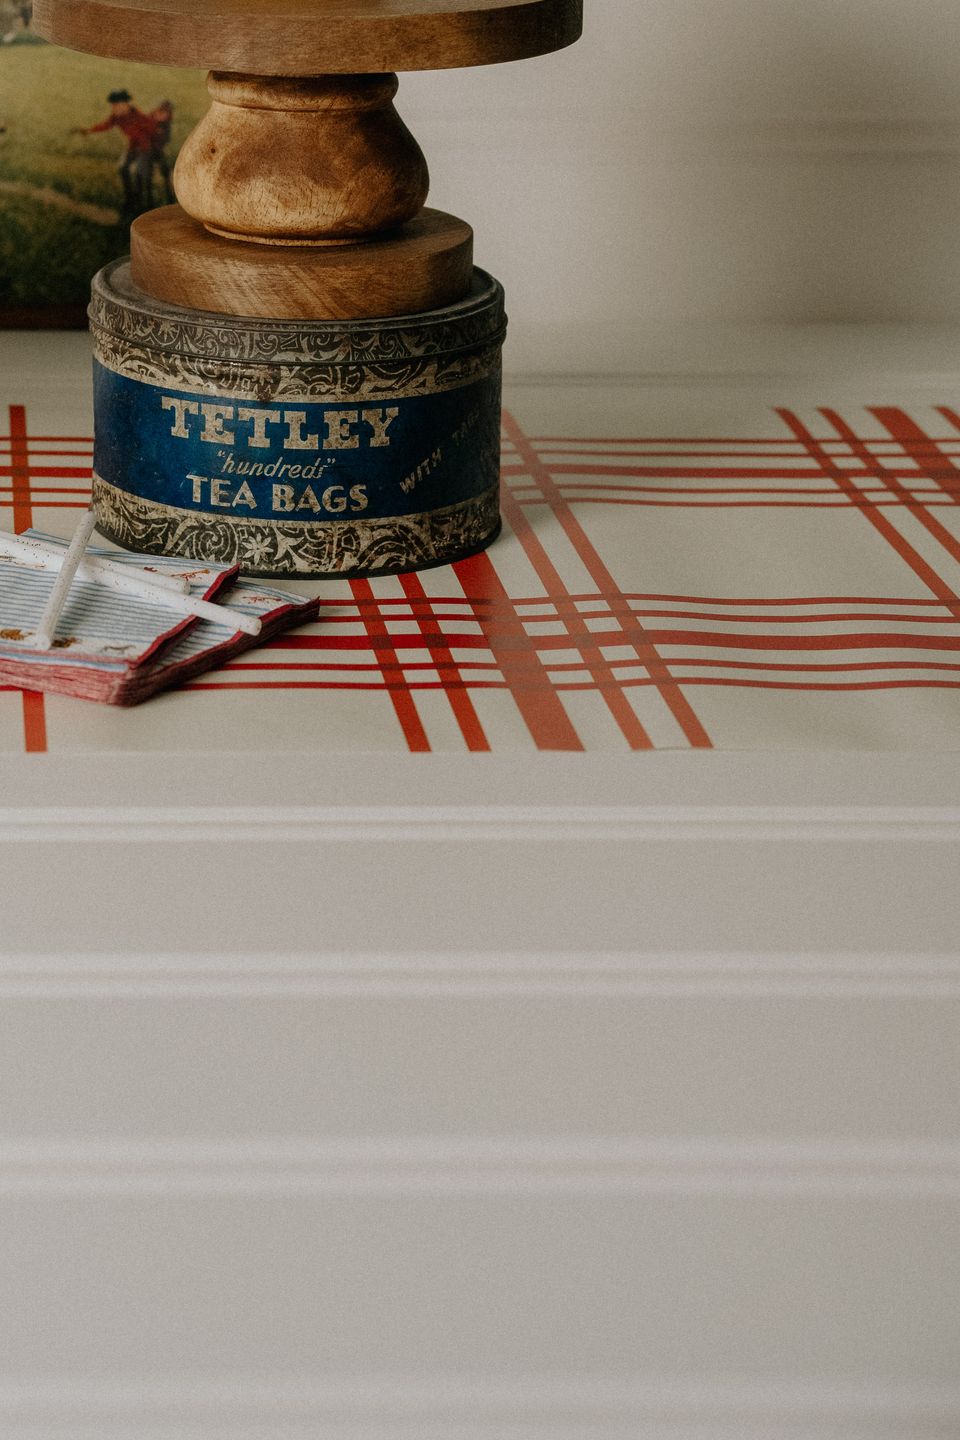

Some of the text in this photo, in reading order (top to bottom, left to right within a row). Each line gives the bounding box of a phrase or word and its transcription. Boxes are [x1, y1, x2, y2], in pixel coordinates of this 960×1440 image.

[161, 396, 400, 450] TETLEY
[186, 474, 369, 513] TEA BAGS
[400, 447, 442, 495] WITH
